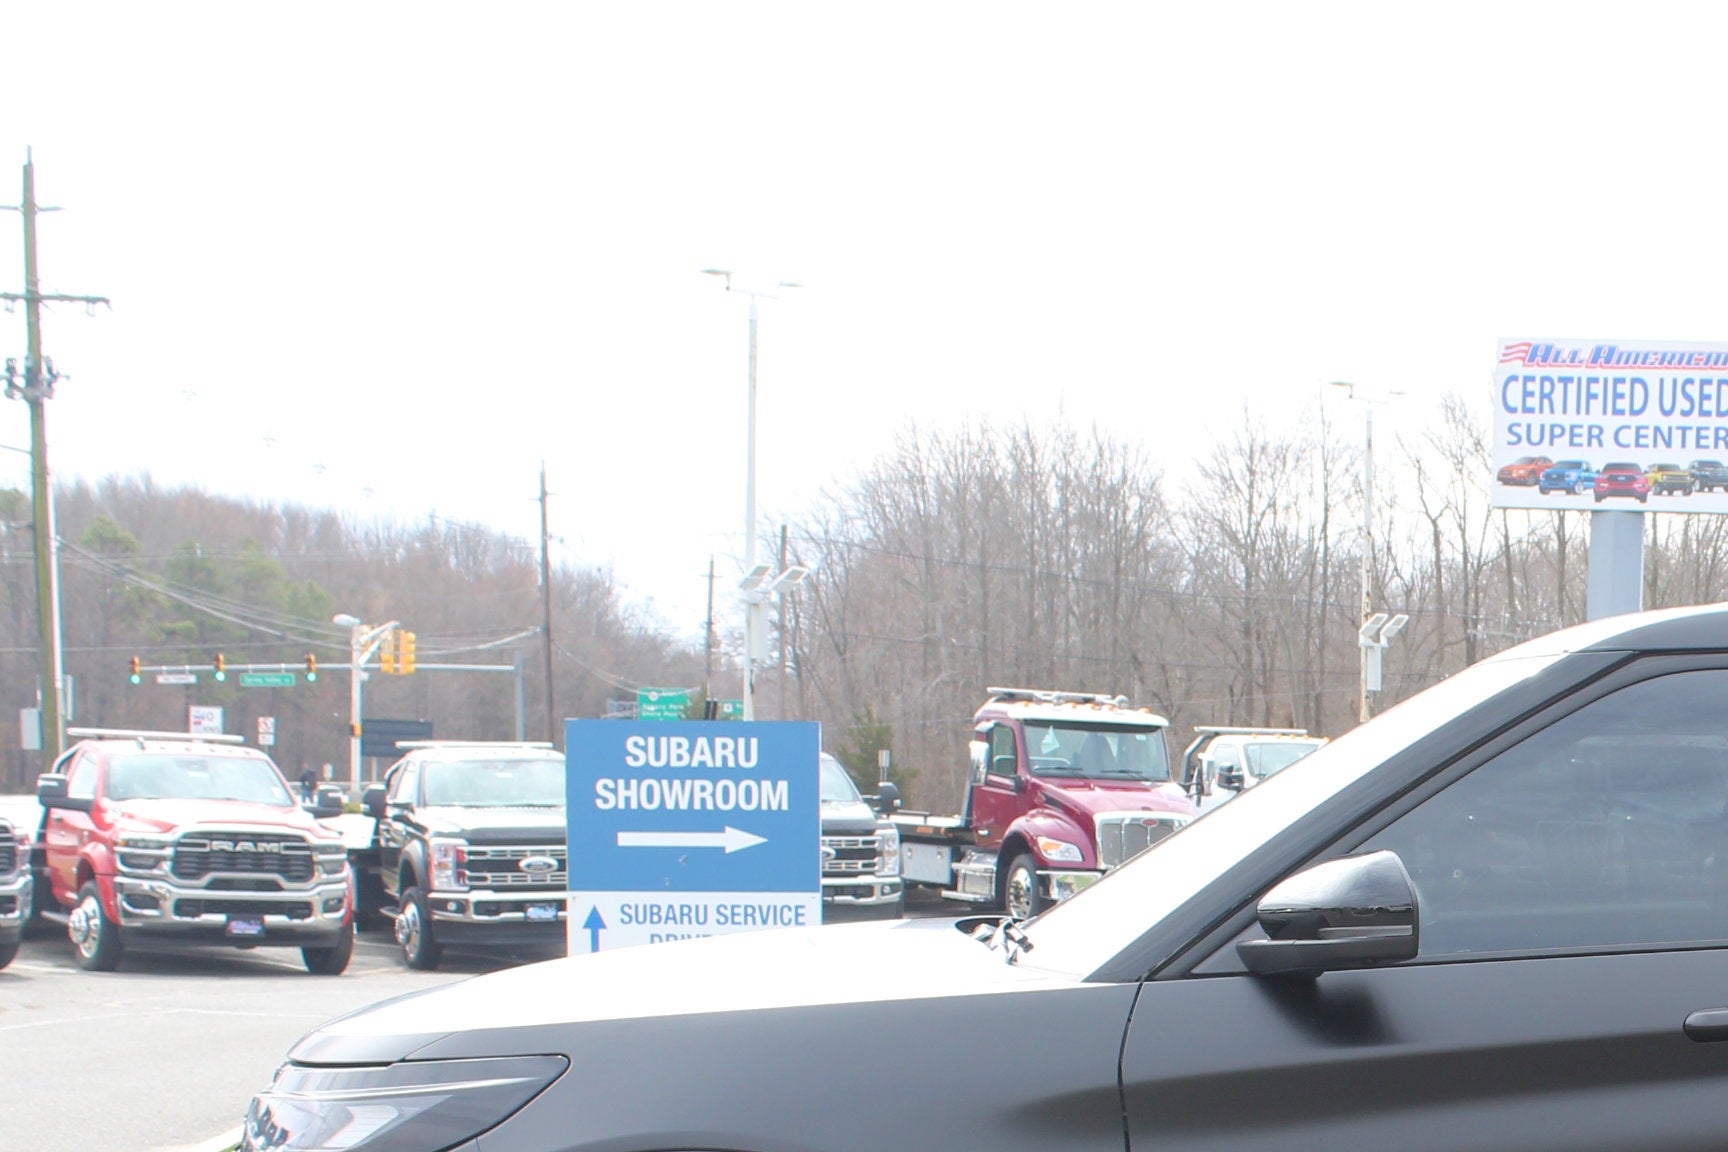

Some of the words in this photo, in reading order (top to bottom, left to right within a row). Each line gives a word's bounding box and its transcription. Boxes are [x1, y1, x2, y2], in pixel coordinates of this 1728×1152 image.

[1501, 374, 1649, 416] CERTIFIED
[1506, 422, 1604, 447] SUPER
[625, 735, 759, 768] SUBARU
[594, 778, 789, 811] SHOWROOM
[211, 841, 280, 852] RAM
[620, 903, 708, 925] SUBARU
[715, 904, 806, 926] SERVICE
